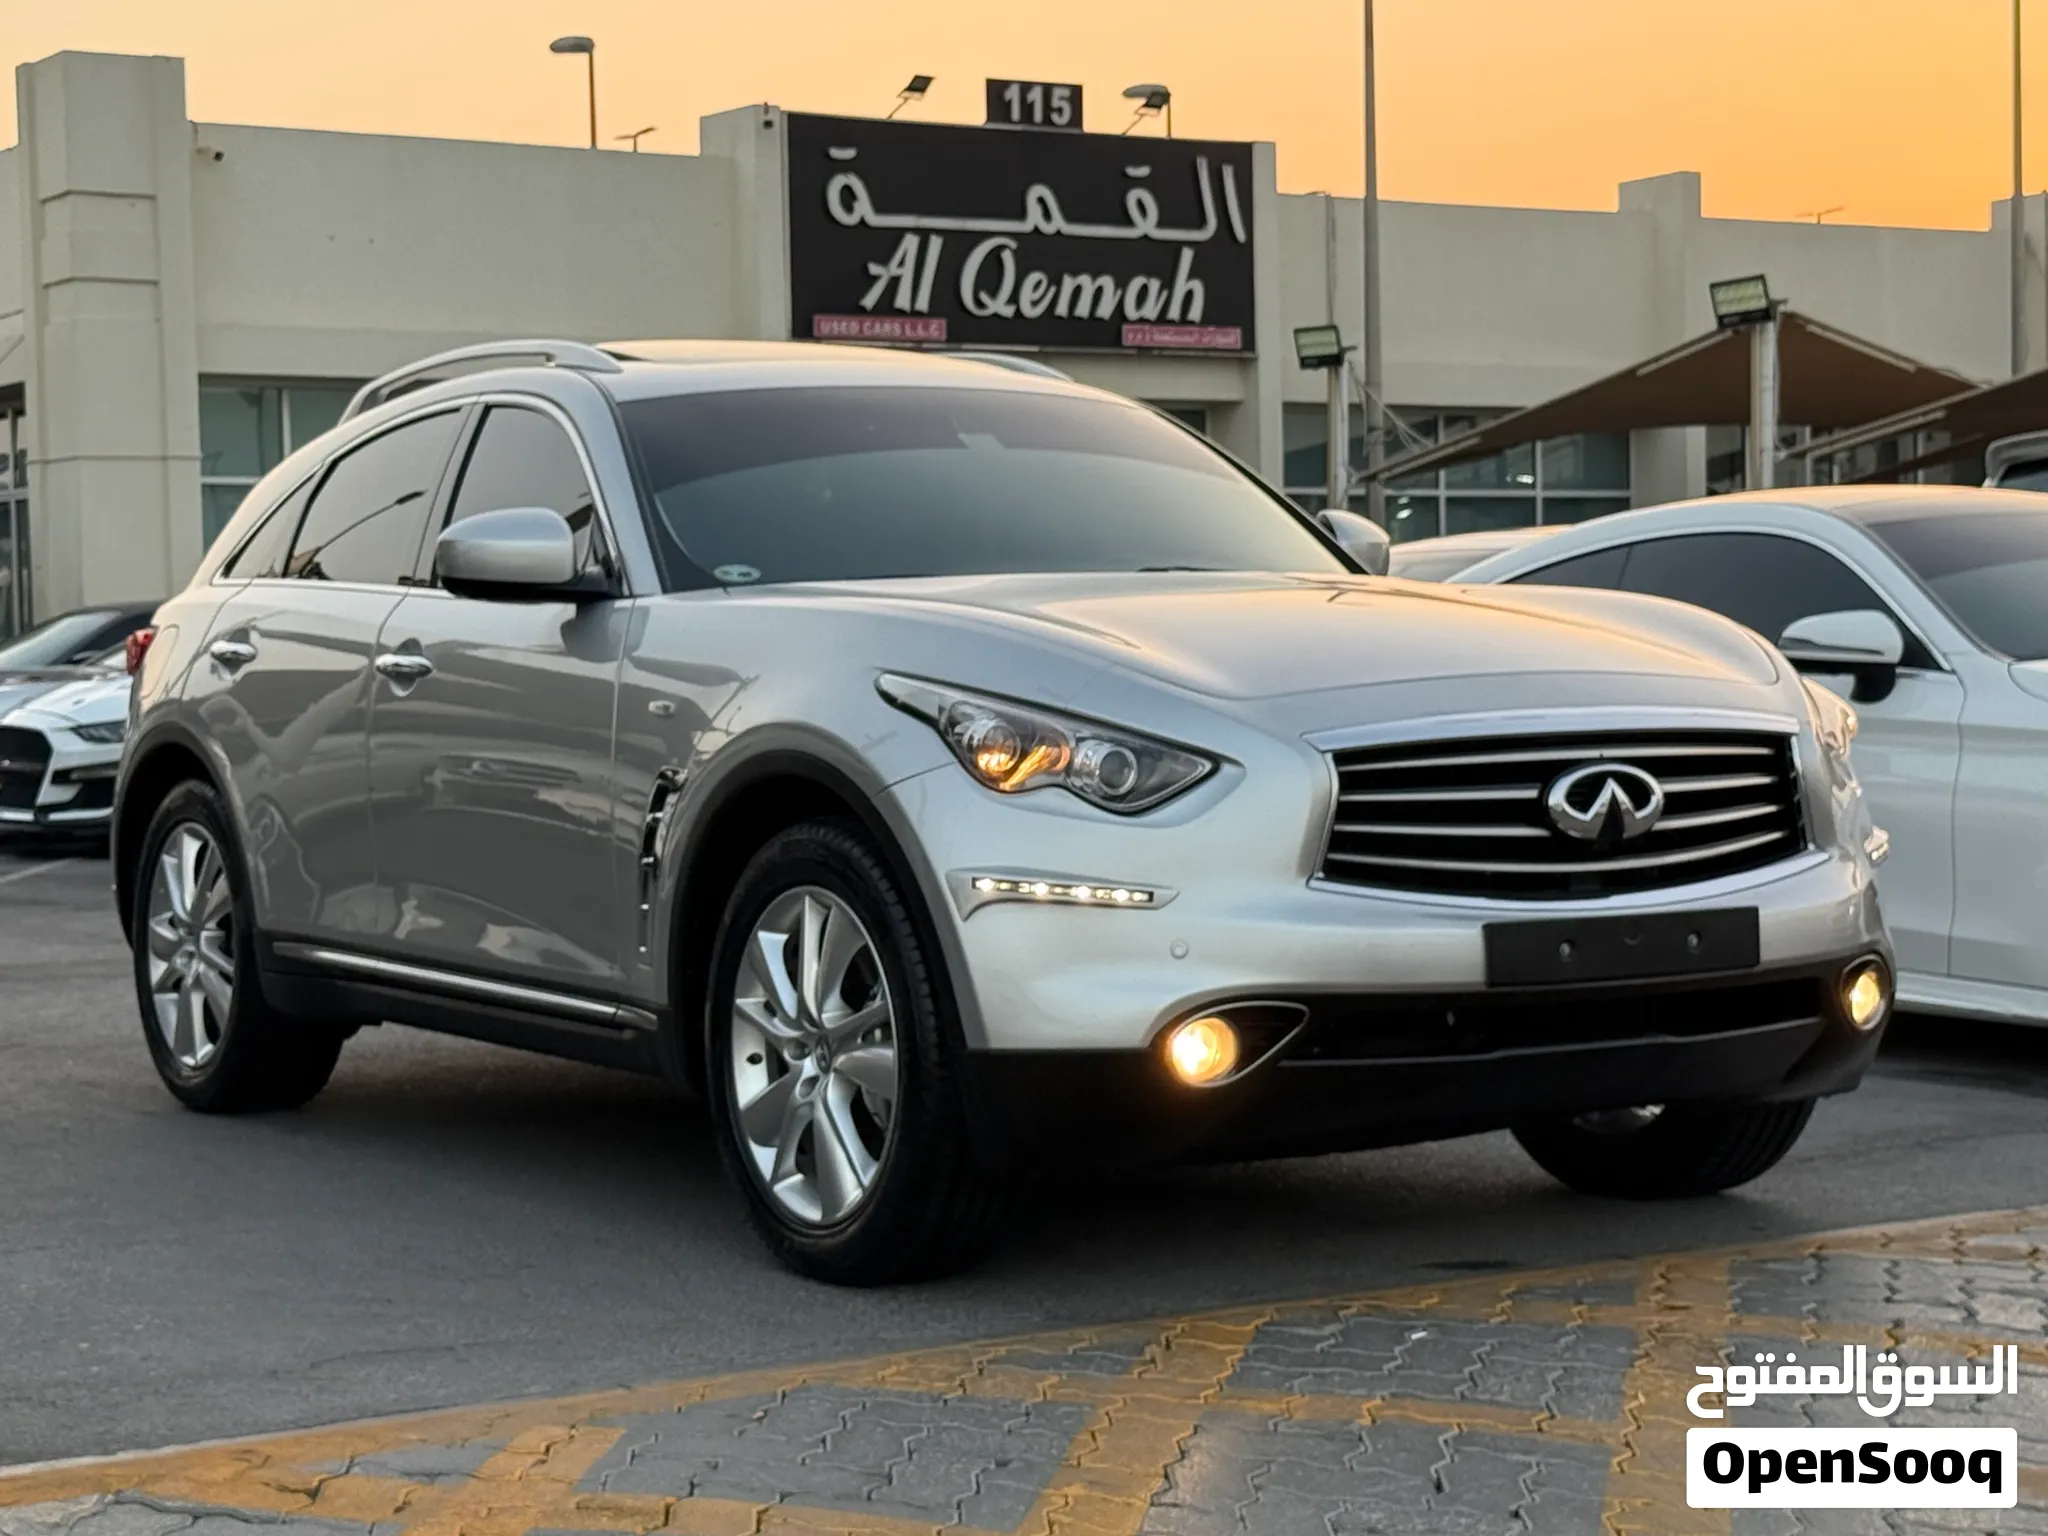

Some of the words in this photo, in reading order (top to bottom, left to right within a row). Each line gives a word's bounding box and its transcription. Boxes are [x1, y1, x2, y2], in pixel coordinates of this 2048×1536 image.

[1004, 82, 1072, 127] 115
[826, 146, 1247, 243] القمة
[859, 232, 944, 313] Al
[960, 236, 1206, 323] Qemah
[819, 319, 860, 336] USED
[862, 320, 901, 337] CARS
